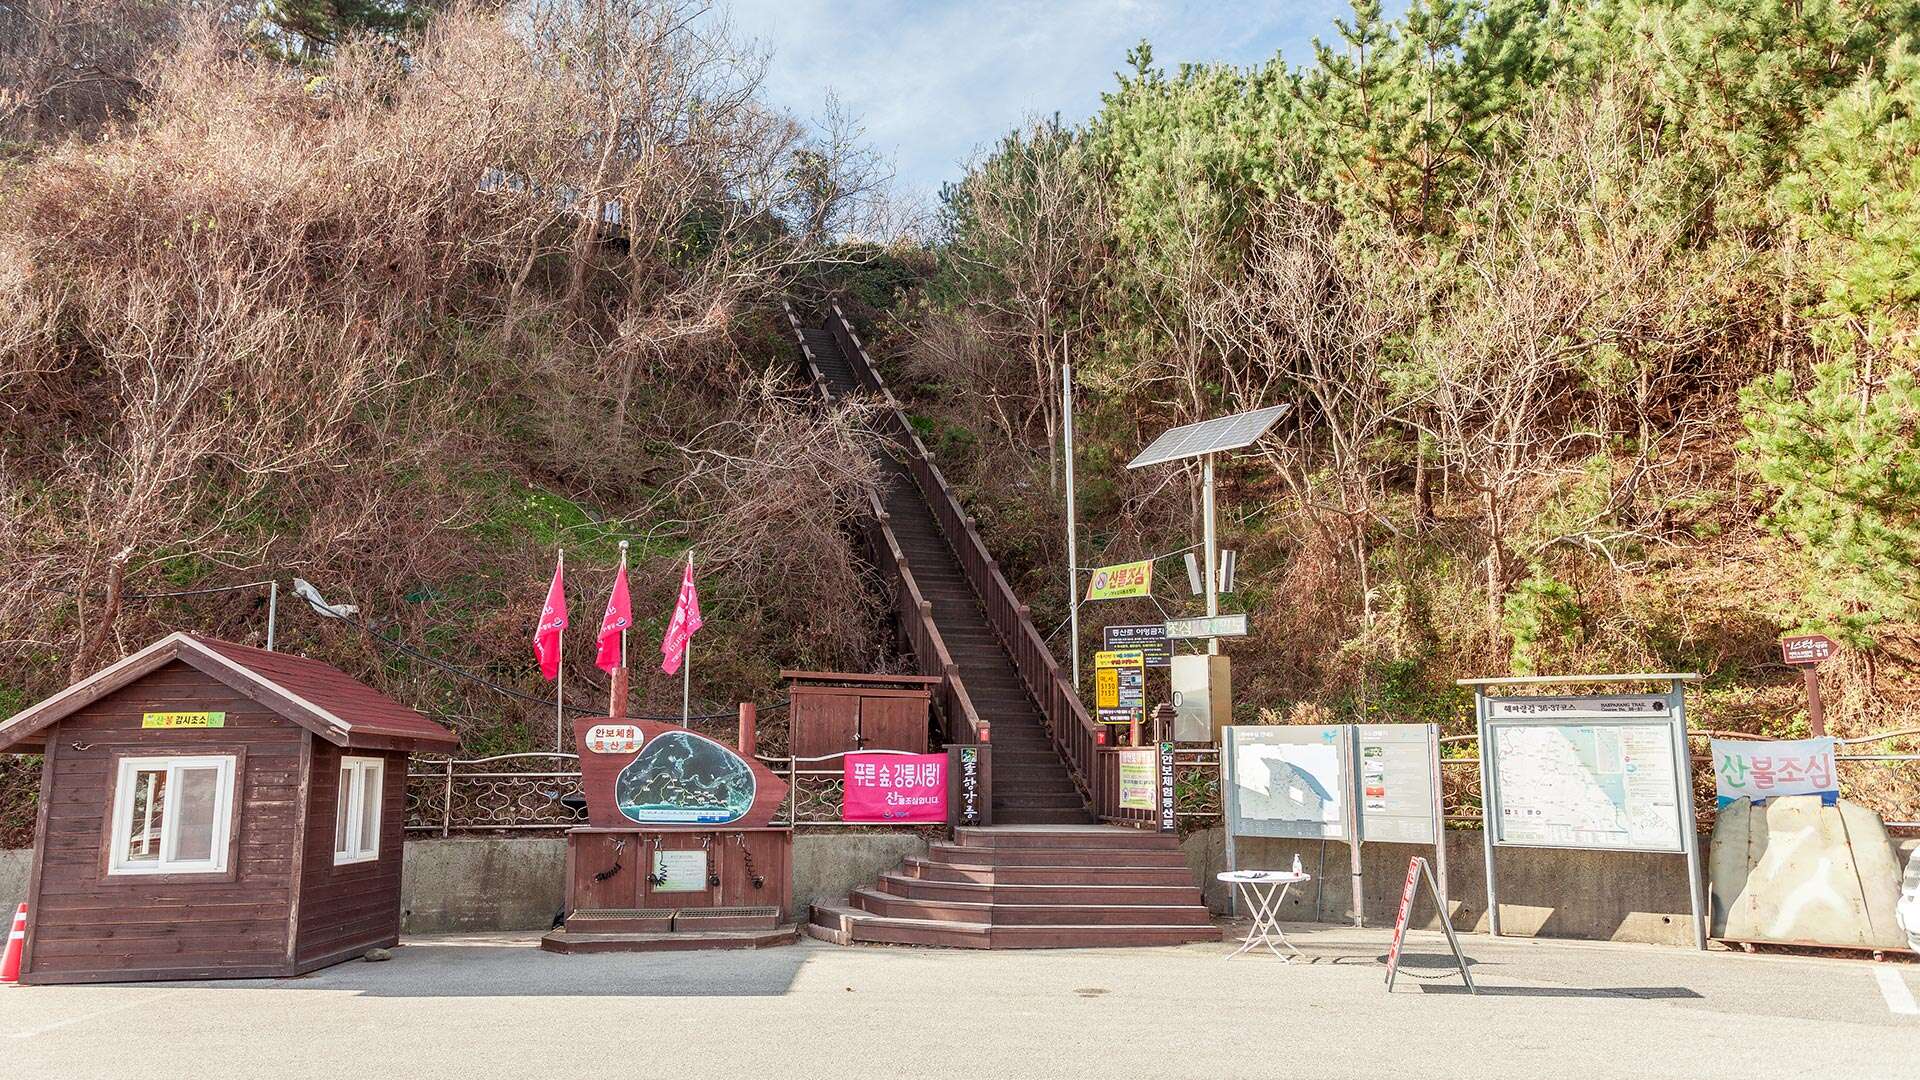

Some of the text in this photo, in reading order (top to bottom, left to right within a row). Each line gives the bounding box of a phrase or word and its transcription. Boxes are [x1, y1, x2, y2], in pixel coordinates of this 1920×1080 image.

[1109, 567, 1145, 589] 산불조심
[1503, 704, 1536, 714] 해파랑길
[595, 727, 635, 739] 안보체험
[854, 763, 940, 788] 푸른 숲, 강릉사랑!
[1720, 752, 1832, 790] 산불조심
